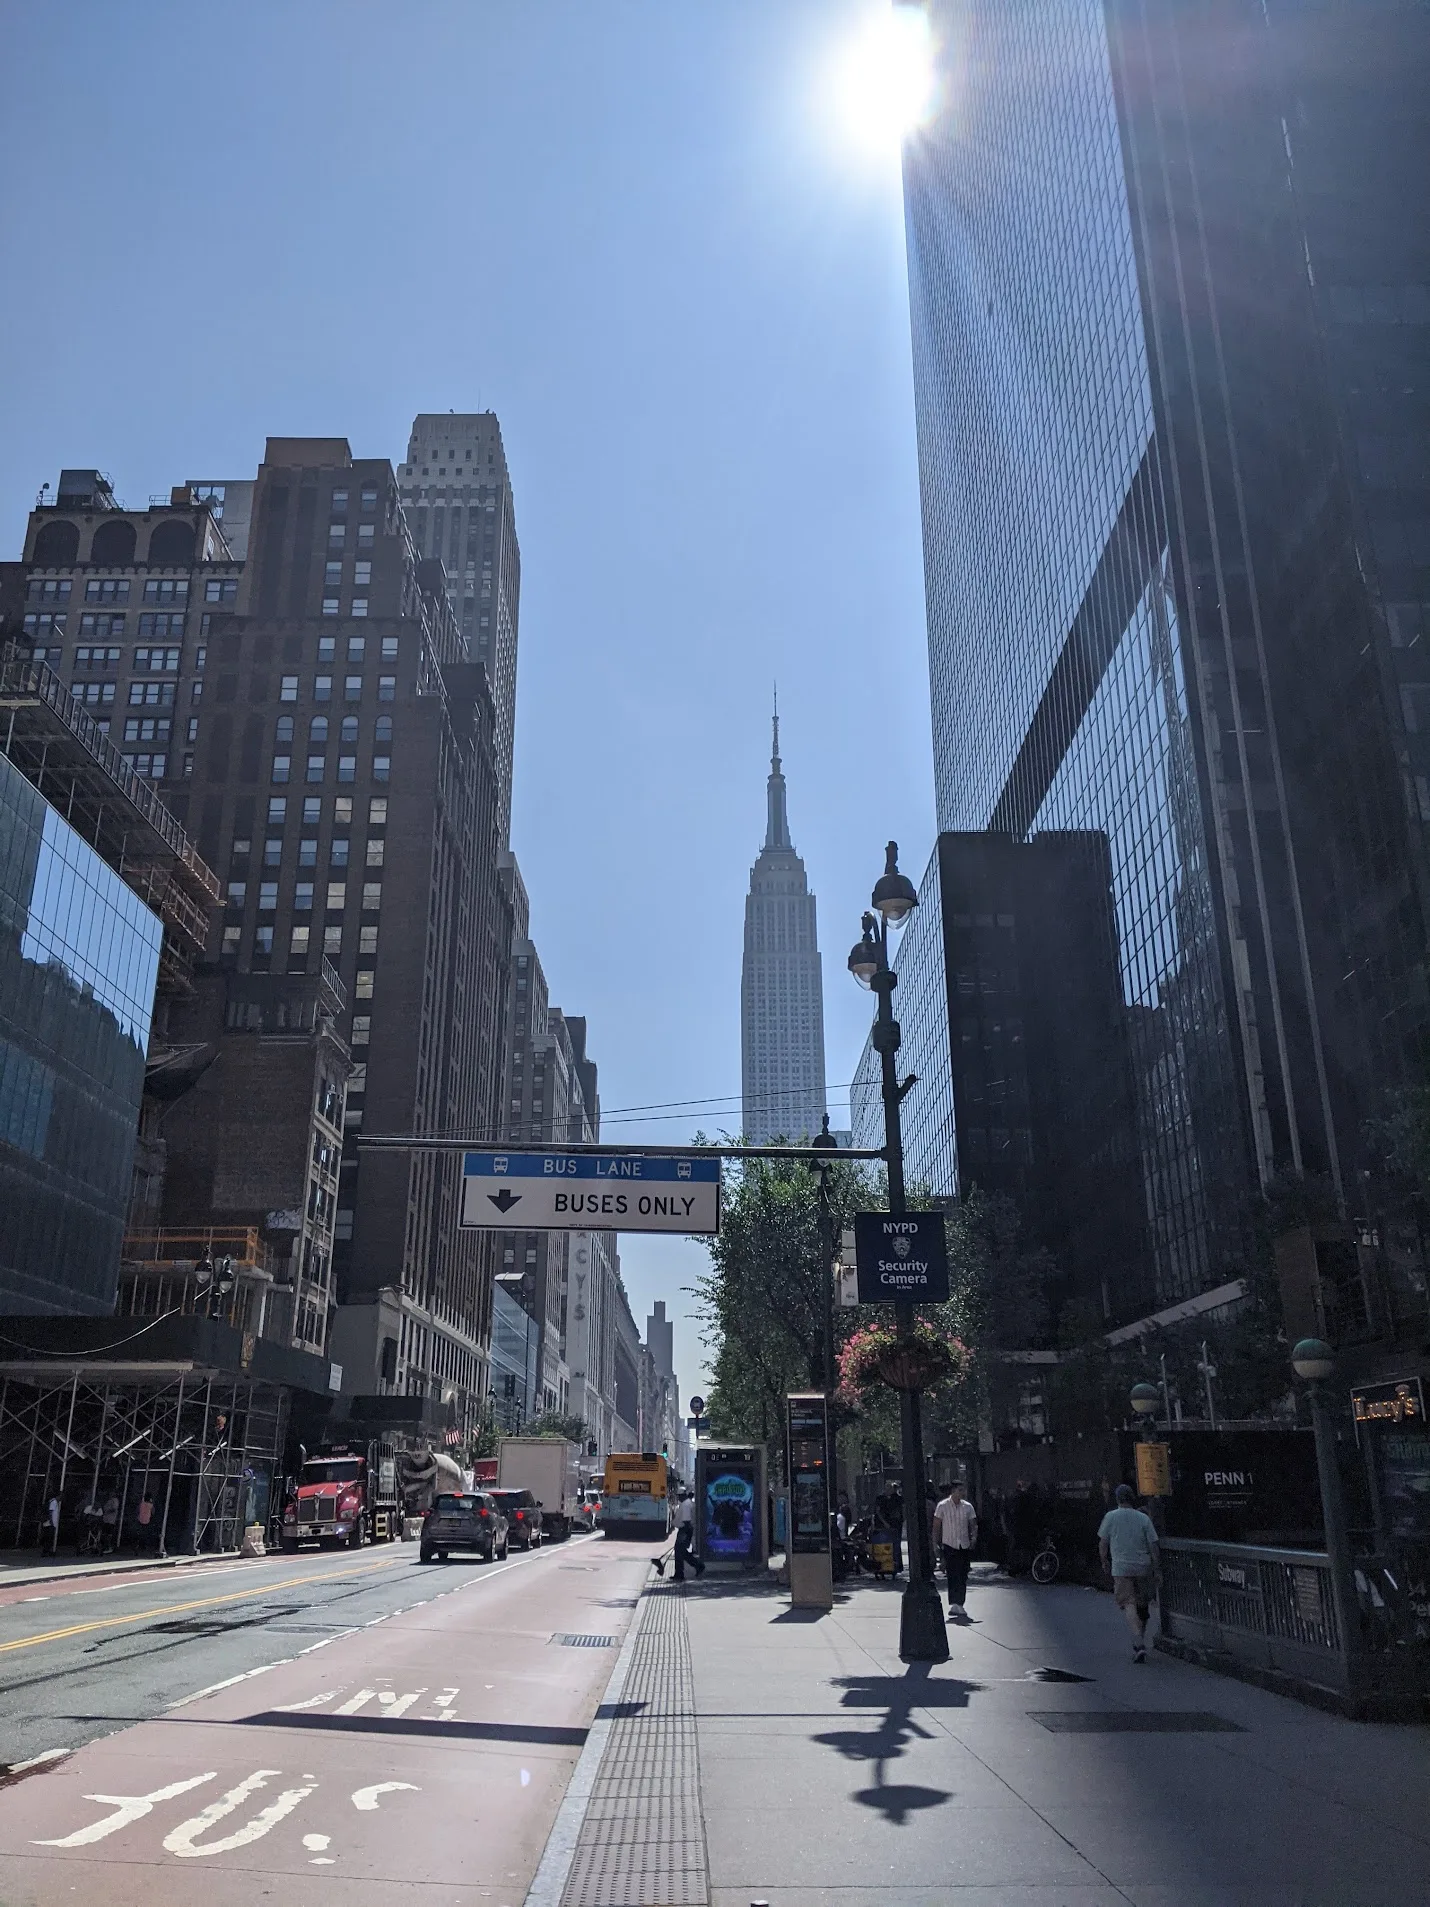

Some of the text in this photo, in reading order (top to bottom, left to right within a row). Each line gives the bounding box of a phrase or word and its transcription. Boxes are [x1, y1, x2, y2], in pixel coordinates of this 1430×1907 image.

[543, 1159, 642, 1177] BUS LANE
[554, 1193, 696, 1217] BUSES ONLY
[883, 1223, 918, 1233] NYPD
[878, 1260, 928, 1274] Security
[880, 1273, 928, 1284] Camera
[1204, 1471, 1253, 1486] PENN 1
[1218, 1562, 1245, 1589] Subway
